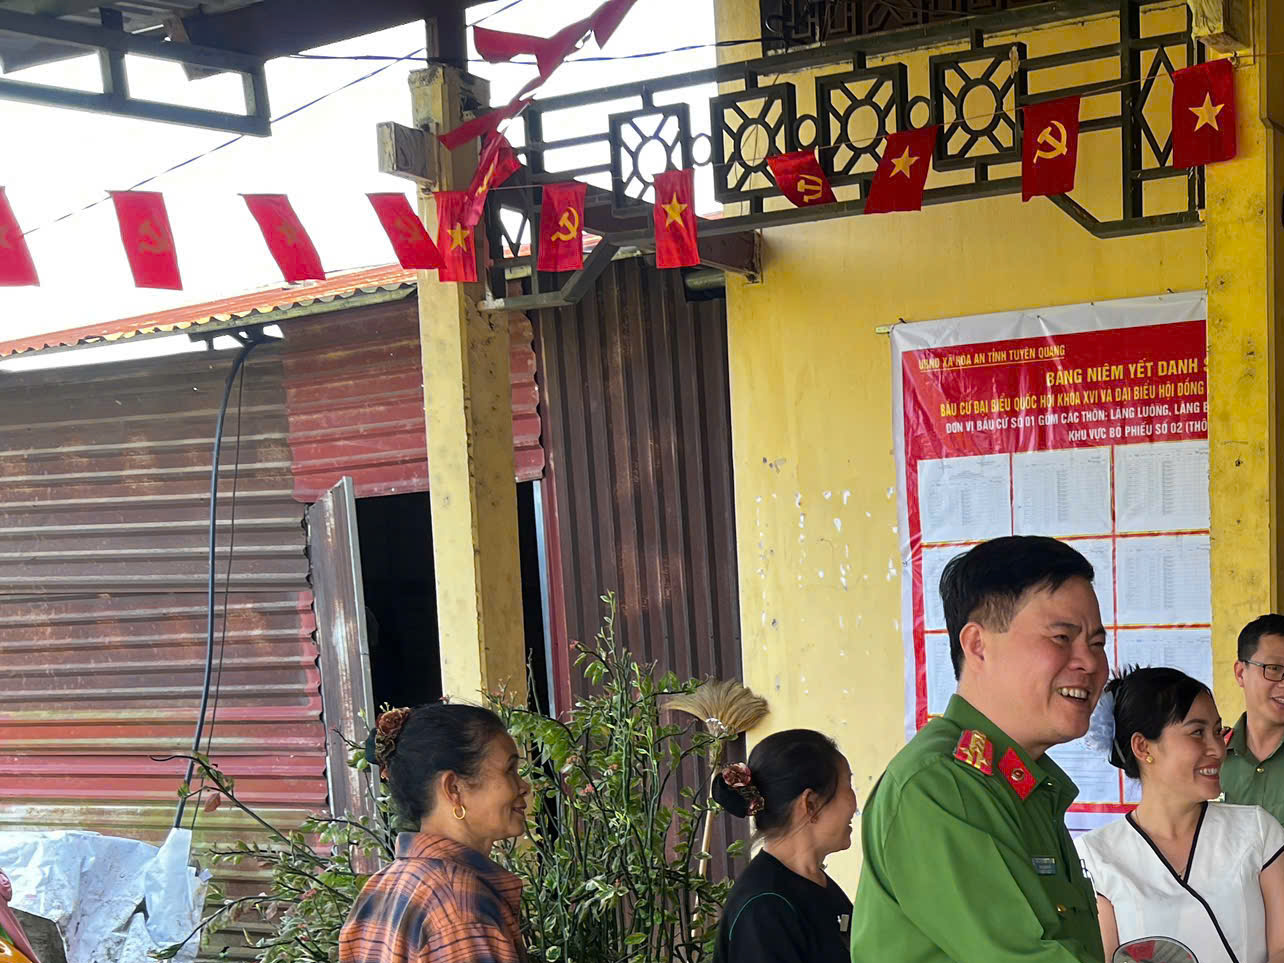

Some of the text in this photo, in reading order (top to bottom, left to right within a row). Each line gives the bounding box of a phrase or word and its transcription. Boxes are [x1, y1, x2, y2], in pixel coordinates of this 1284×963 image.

[974, 353, 985, 364] AN
[988, 348, 1006, 362] TỈNH
[1009, 346, 1035, 360] TUYÊN
[1038, 345, 1065, 358] QUANG
[1087, 363, 1124, 382] NIÊM
[1128, 358, 1153, 378] YẾT
[1158, 358, 1198, 376] DANH
[1083, 389, 1098, 405] XVI
[1134, 380, 1155, 400] BIỂU
[1159, 381, 1174, 400] HỘI
[1025, 416, 1035, 427] 01
[1061, 410, 1079, 424] CÁC
[1069, 430, 1087, 441] KHU
[1089, 426, 1106, 442] VỰC
[1125, 421, 1152, 437] PHIẾU
[1155, 418, 1168, 434] SỐ
[1170, 422, 1183, 434] 02
